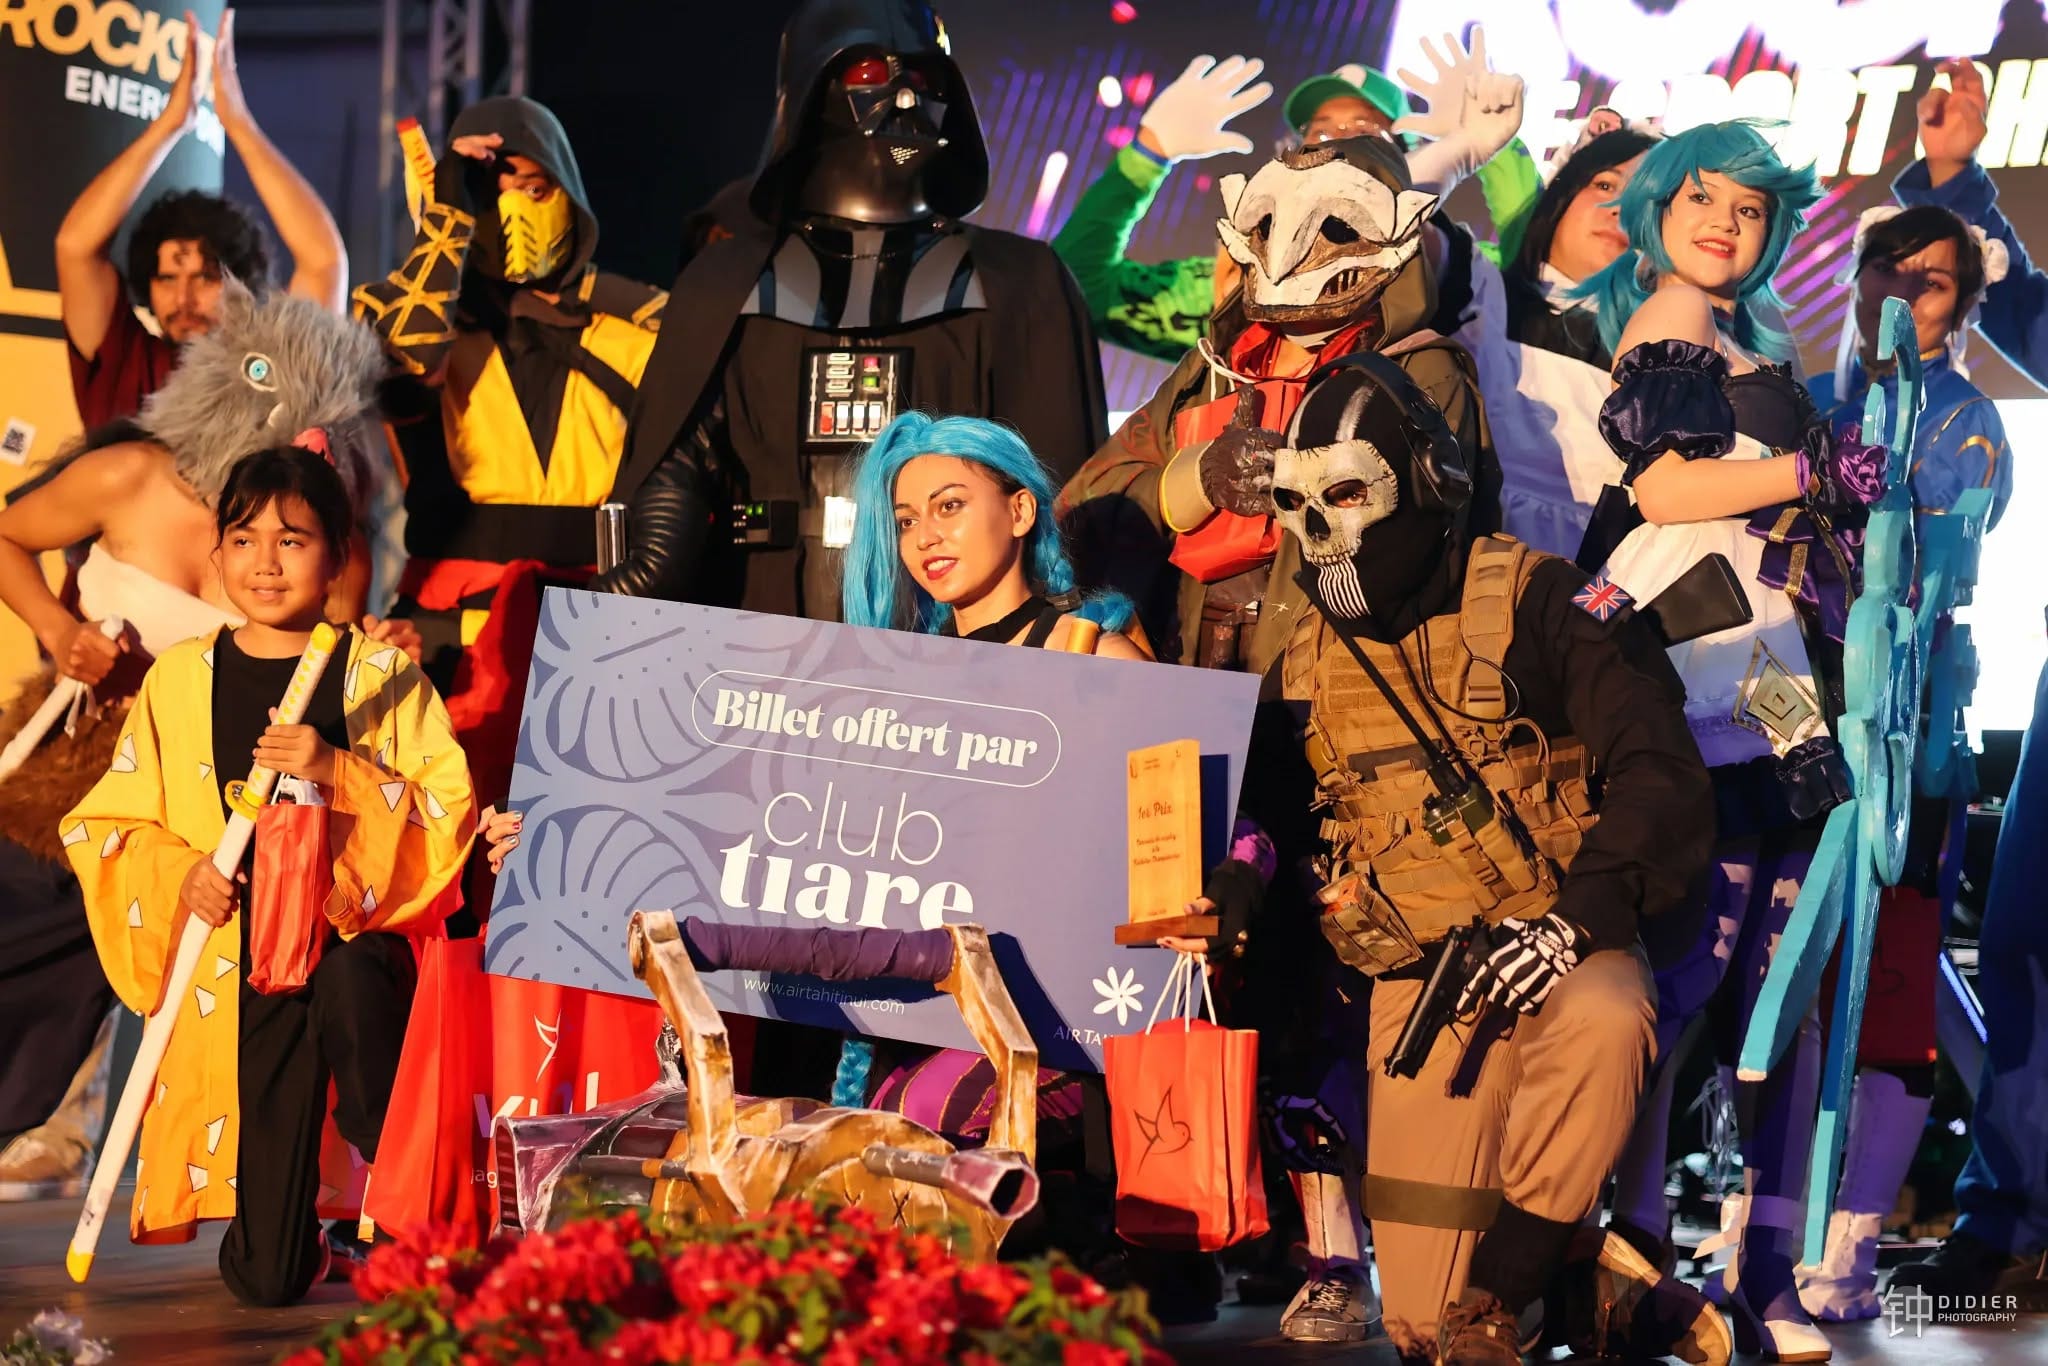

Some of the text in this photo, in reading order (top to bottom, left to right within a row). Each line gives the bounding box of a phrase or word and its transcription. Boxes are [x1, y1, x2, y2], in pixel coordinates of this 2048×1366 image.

[712, 689, 1038, 771] Billet offert par
[764, 781, 943, 866] club
[720, 833, 974, 932] tiare
[743, 977, 906, 1016] www.airtahitinui.com
[1053, 1025, 1082, 1044] AIR
